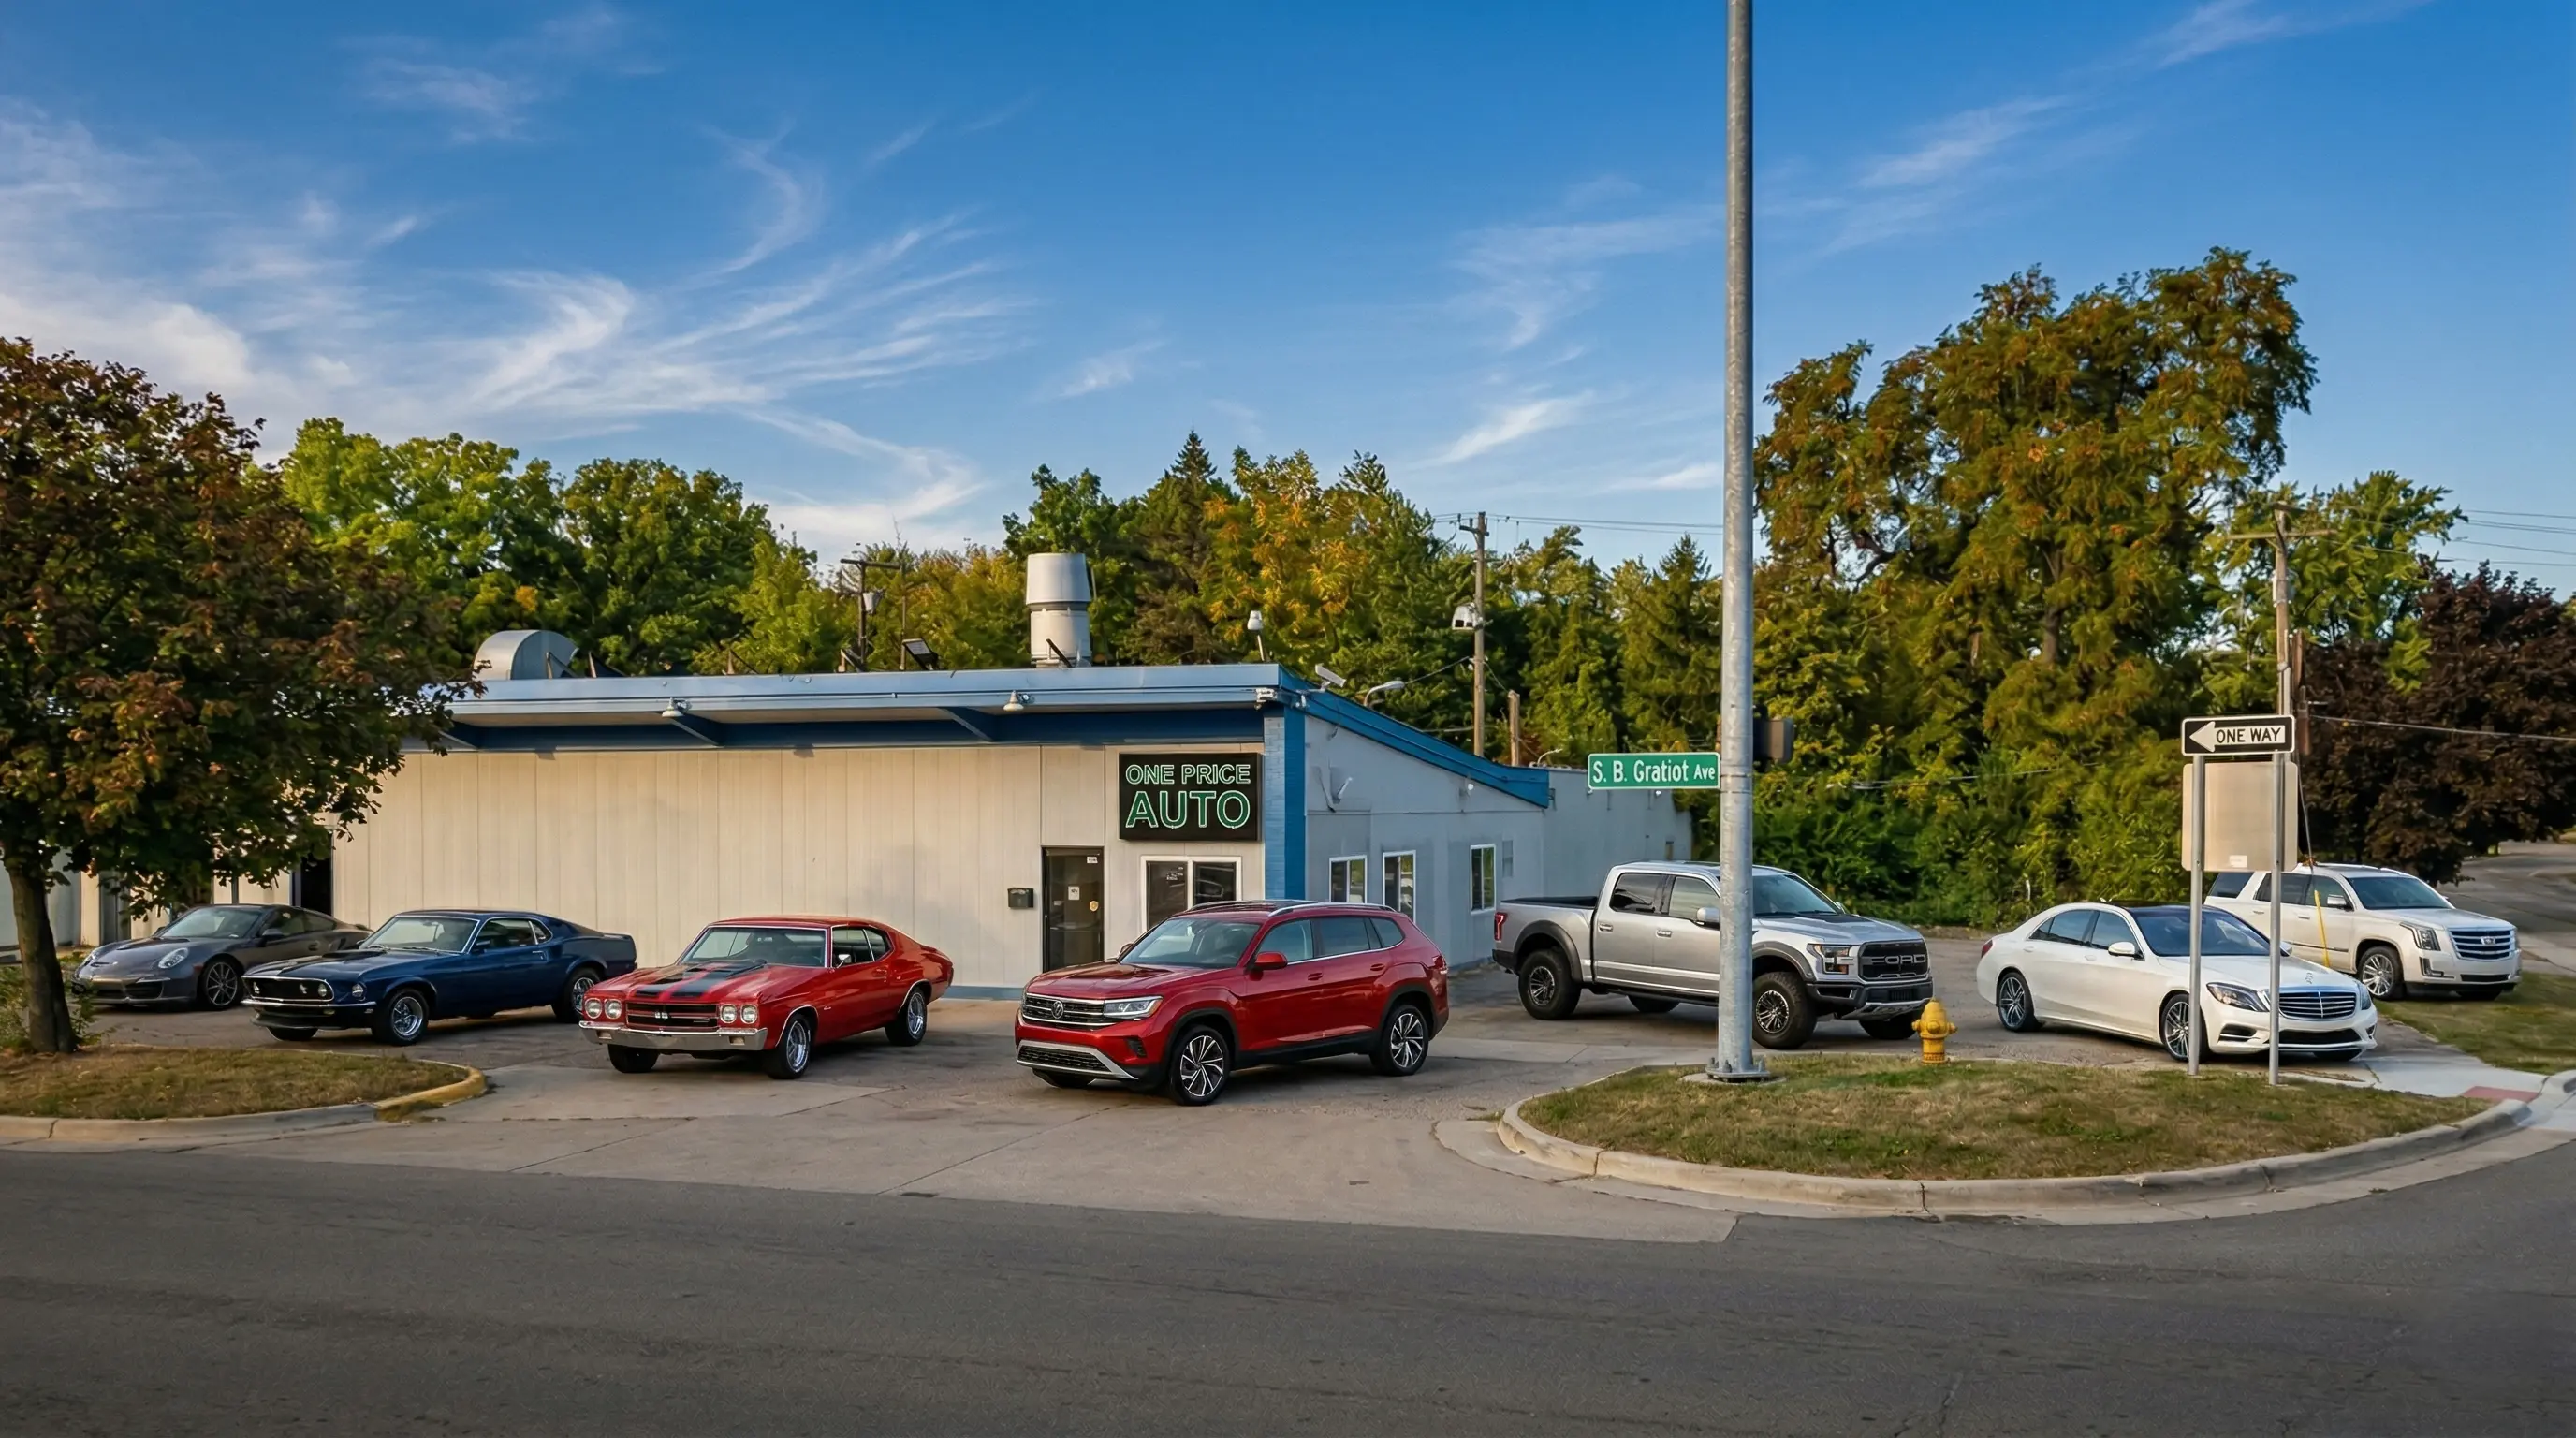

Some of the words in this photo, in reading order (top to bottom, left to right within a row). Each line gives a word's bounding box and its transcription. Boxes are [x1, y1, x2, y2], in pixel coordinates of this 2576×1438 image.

[2216, 729, 2246, 743] ONE
[2250, 727, 2281, 742] WAY
[1125, 764, 1175, 785] ONE
[1181, 764, 1251, 785] PRICE
[1592, 760, 1607, 783] S.
[1613, 760, 1628, 783] B.
[1633, 759, 1689, 783] Gratiot
[1693, 764, 1715, 780] Ave
[1125, 790, 1251, 829] AUTO
[1867, 954, 1926, 965] FORD
